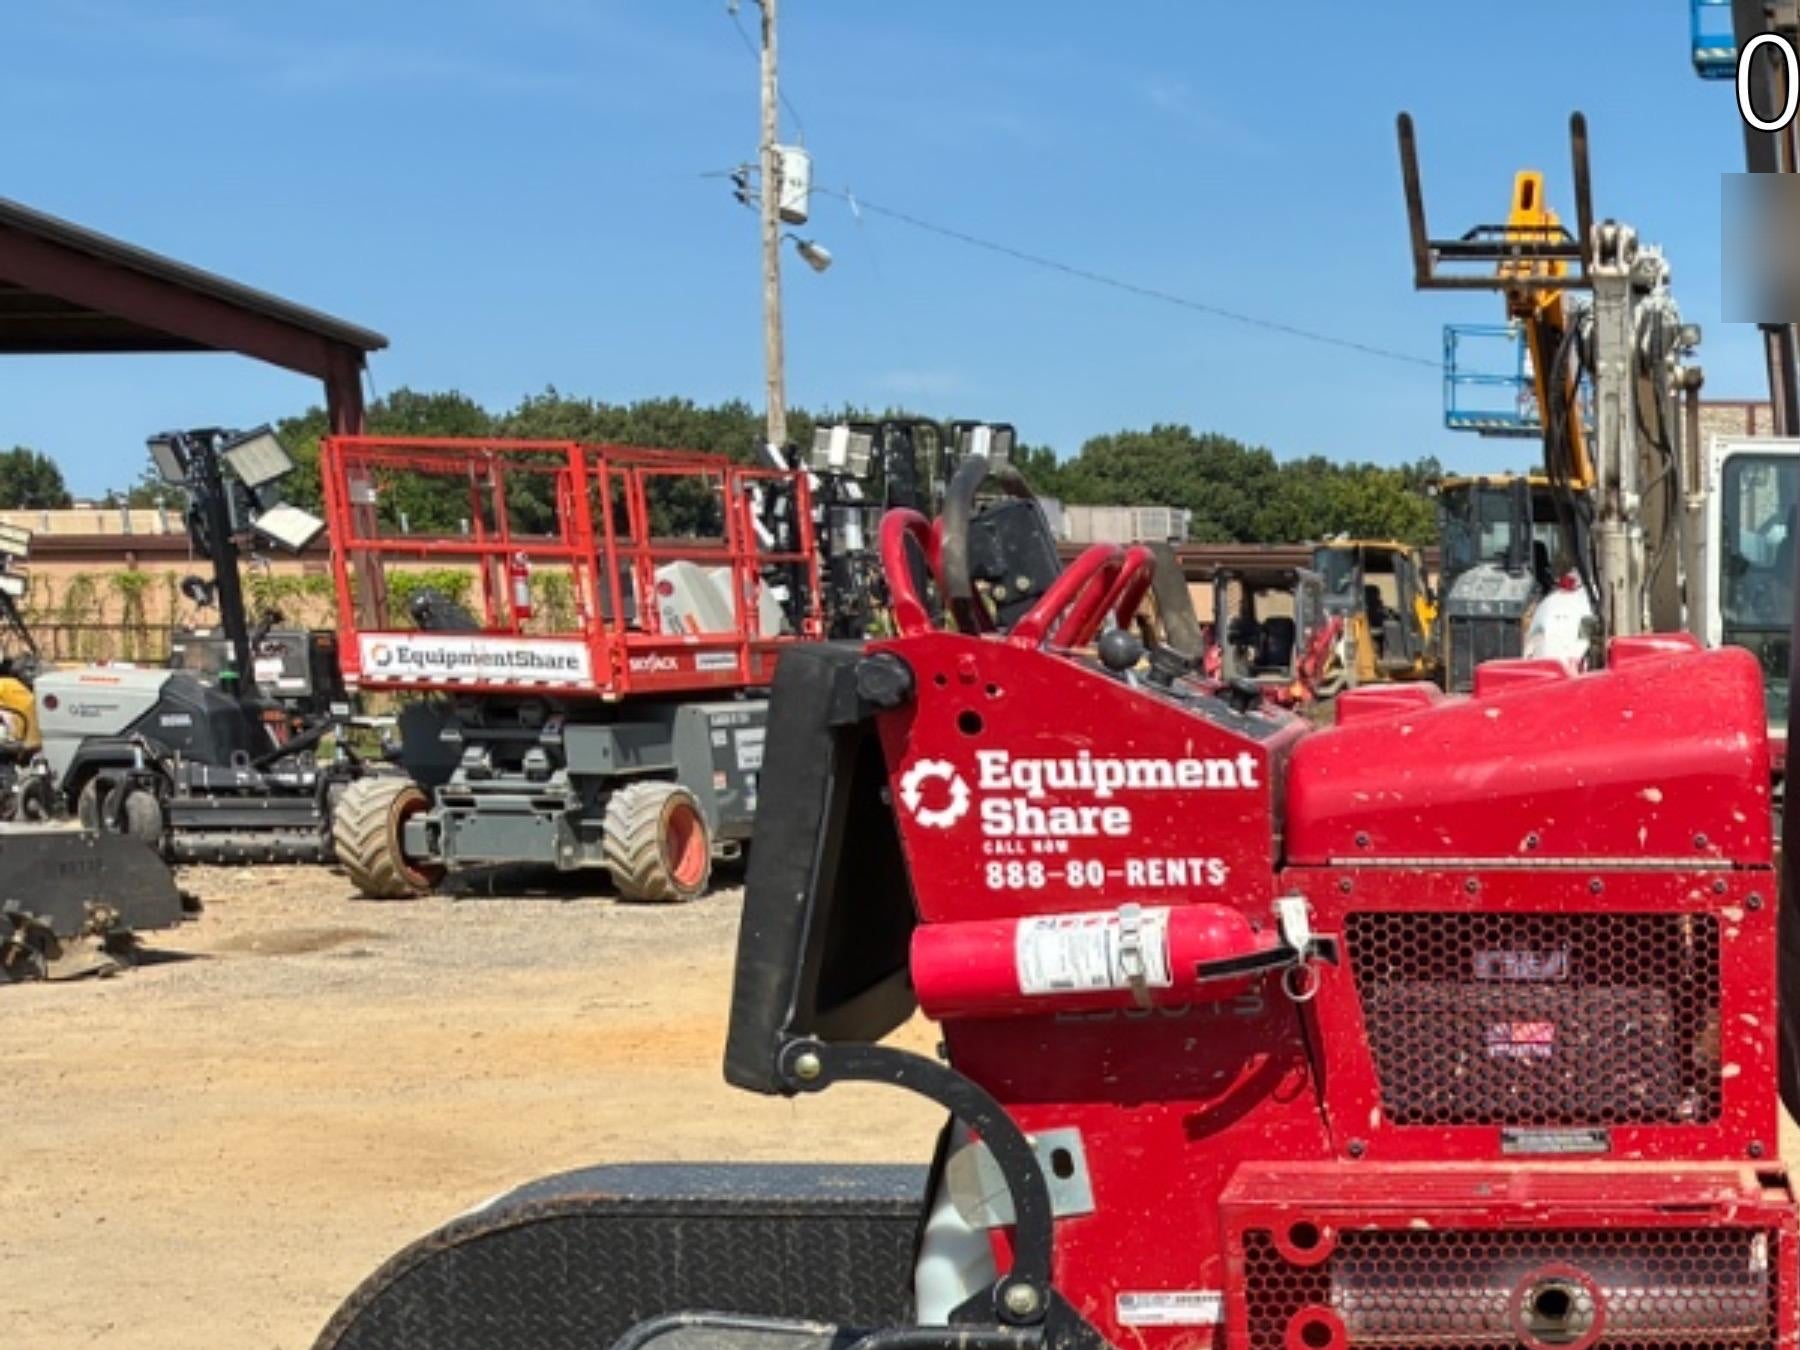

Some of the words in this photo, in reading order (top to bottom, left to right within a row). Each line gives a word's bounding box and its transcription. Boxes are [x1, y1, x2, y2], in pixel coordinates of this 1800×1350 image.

[395, 646, 580, 670] EquipmentShare
[975, 749, 1260, 799] Equipment
[980, 797, 1132, 837] Share
[982, 840, 1026, 855] CALL
[1031, 839, 1070, 854] NOW
[985, 856, 1228, 890] 888-80-RENTS
